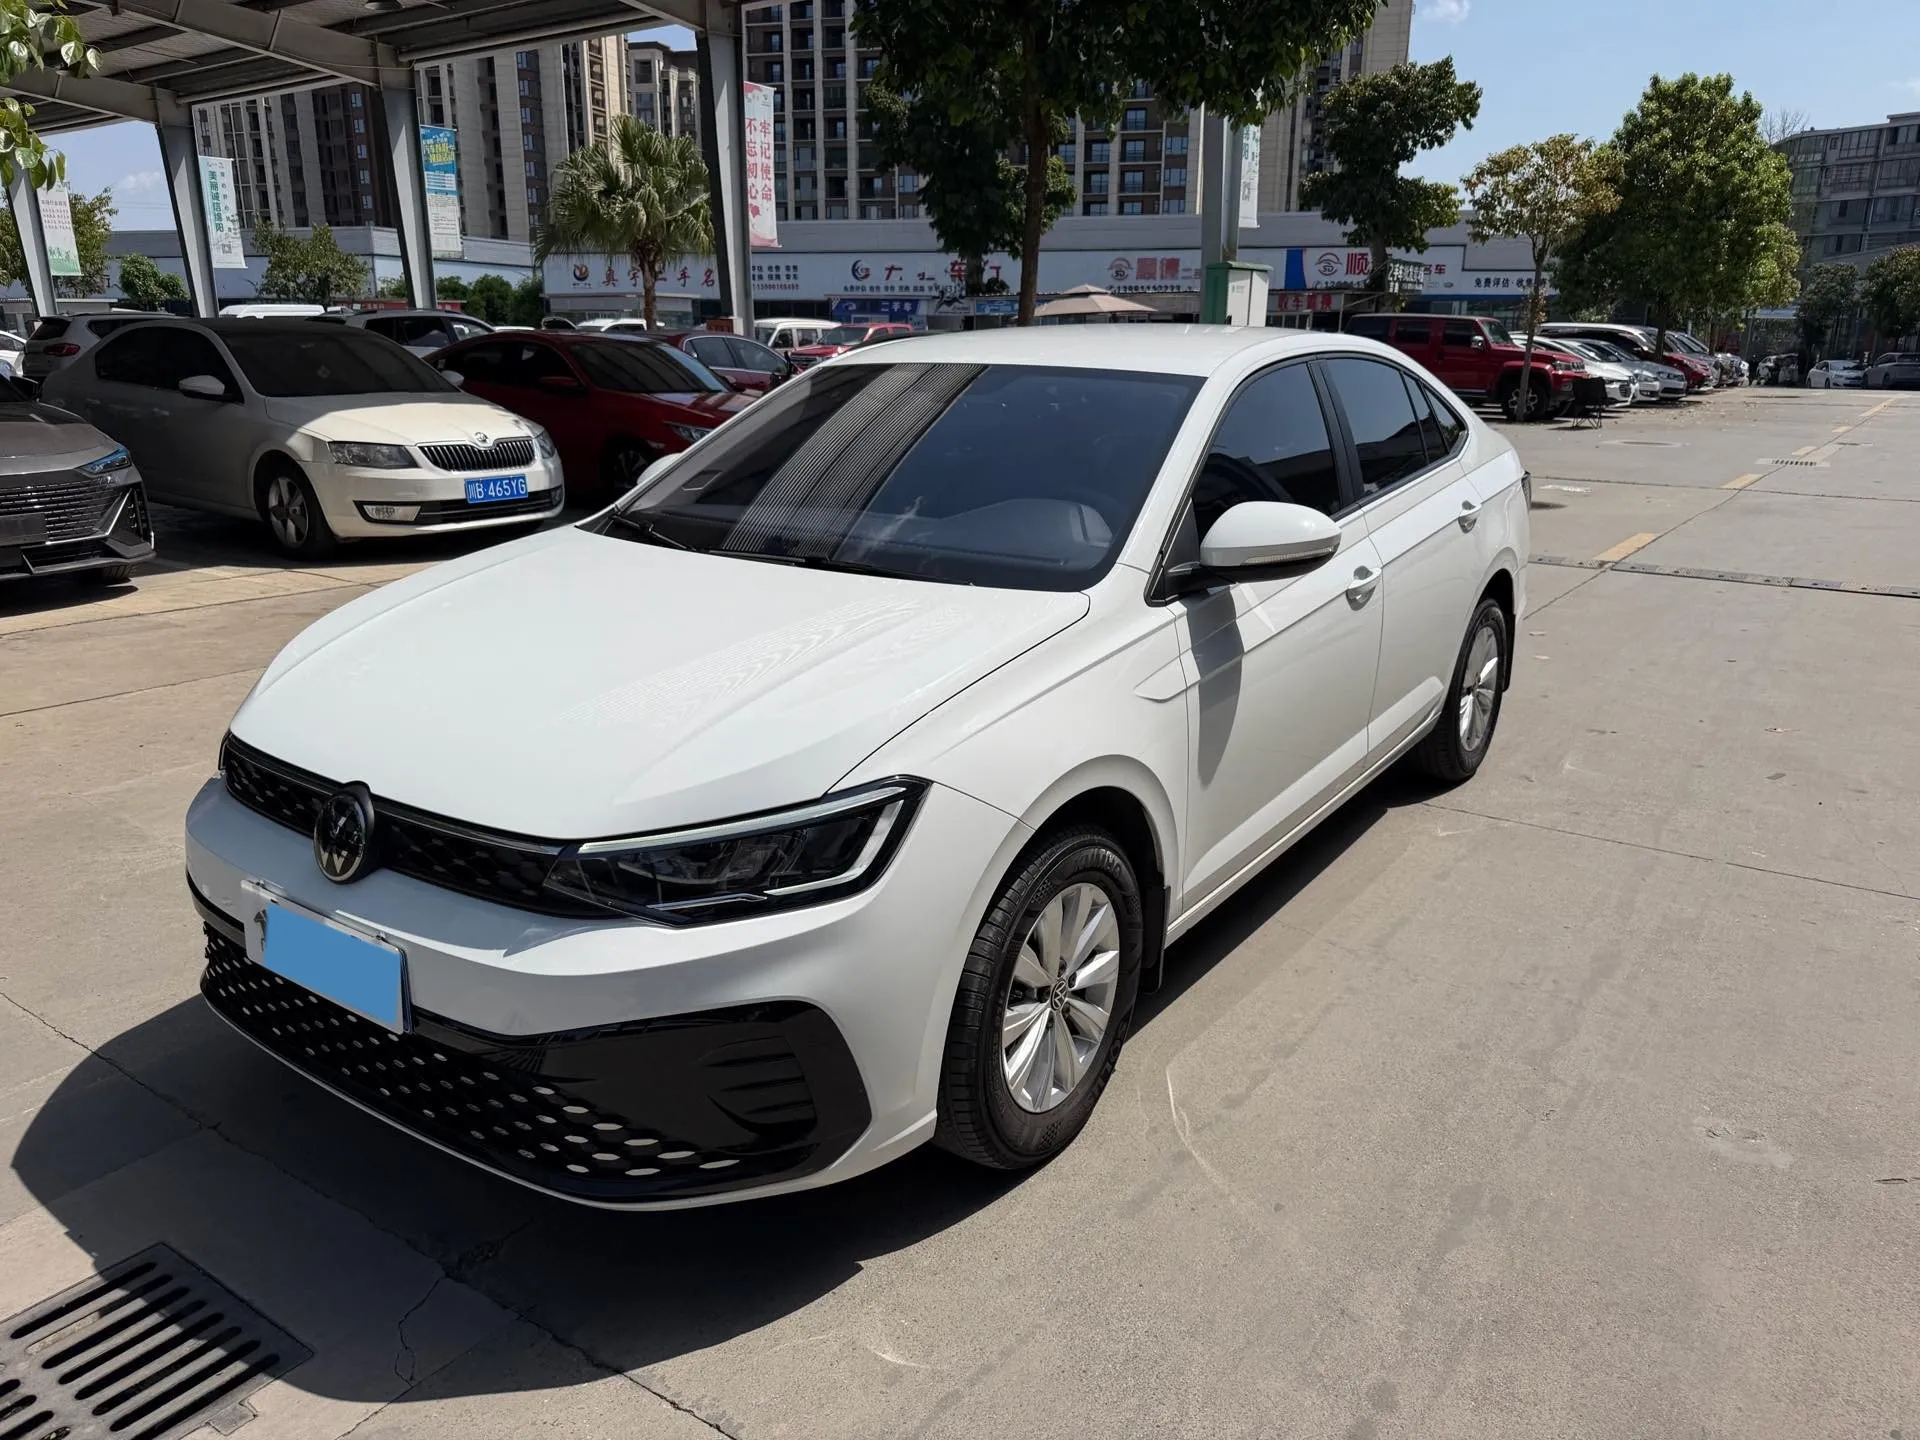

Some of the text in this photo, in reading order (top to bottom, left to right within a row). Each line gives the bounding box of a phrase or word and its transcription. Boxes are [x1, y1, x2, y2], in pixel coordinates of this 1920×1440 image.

[745, 118, 758, 200] 不忘初心
[760, 120, 772, 202] 牢记使命
[880, 300, 914, 313] 二手车
[468, 479, 526, 498] 川B·465YG
